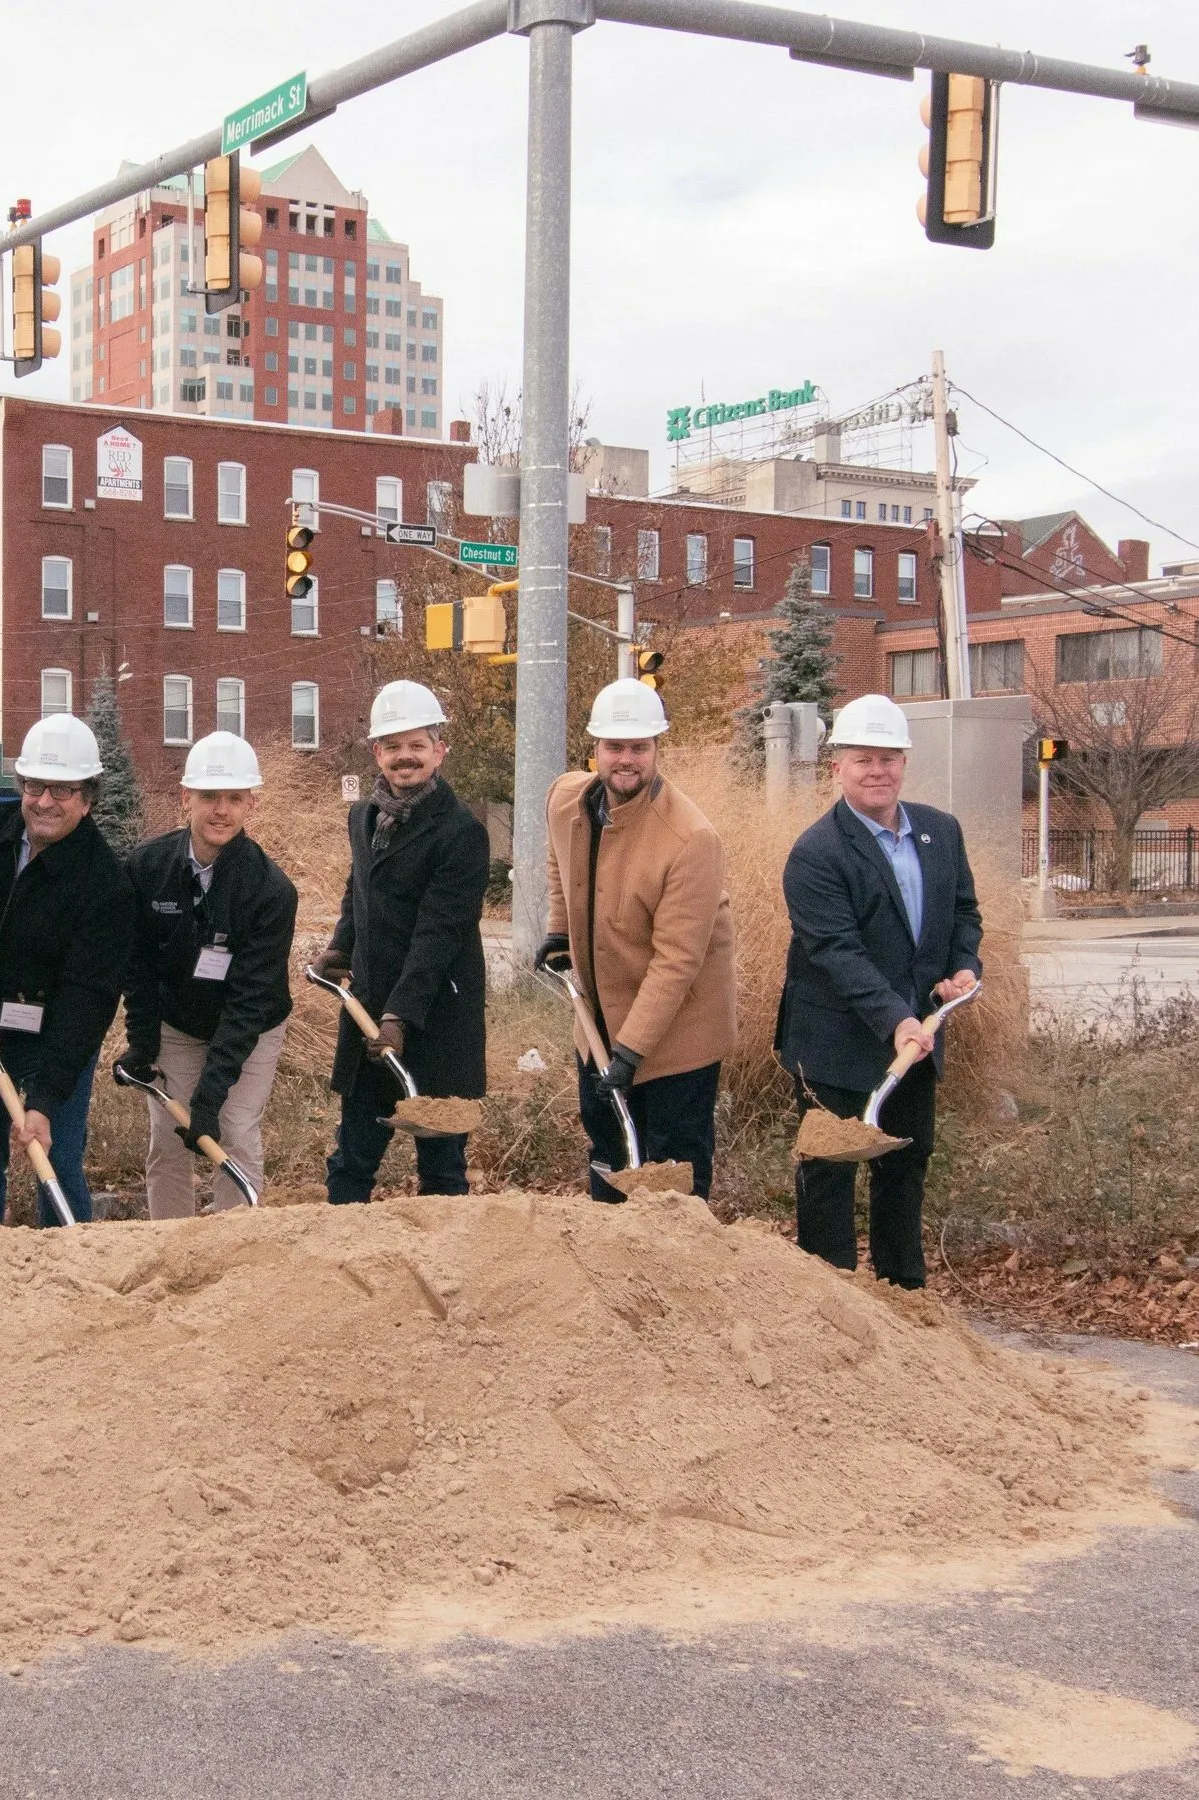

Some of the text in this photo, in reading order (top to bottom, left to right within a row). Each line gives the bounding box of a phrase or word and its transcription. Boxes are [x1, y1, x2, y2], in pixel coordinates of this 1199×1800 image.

[226, 82, 301, 145] Merrimack St
[693, 379, 816, 429] Citizens Bank
[108, 450, 132, 462] RED
[100, 477, 141, 489] APARTMENTS
[399, 530, 432, 540] ONE WAY
[462, 547, 515, 562] Chestnut St
